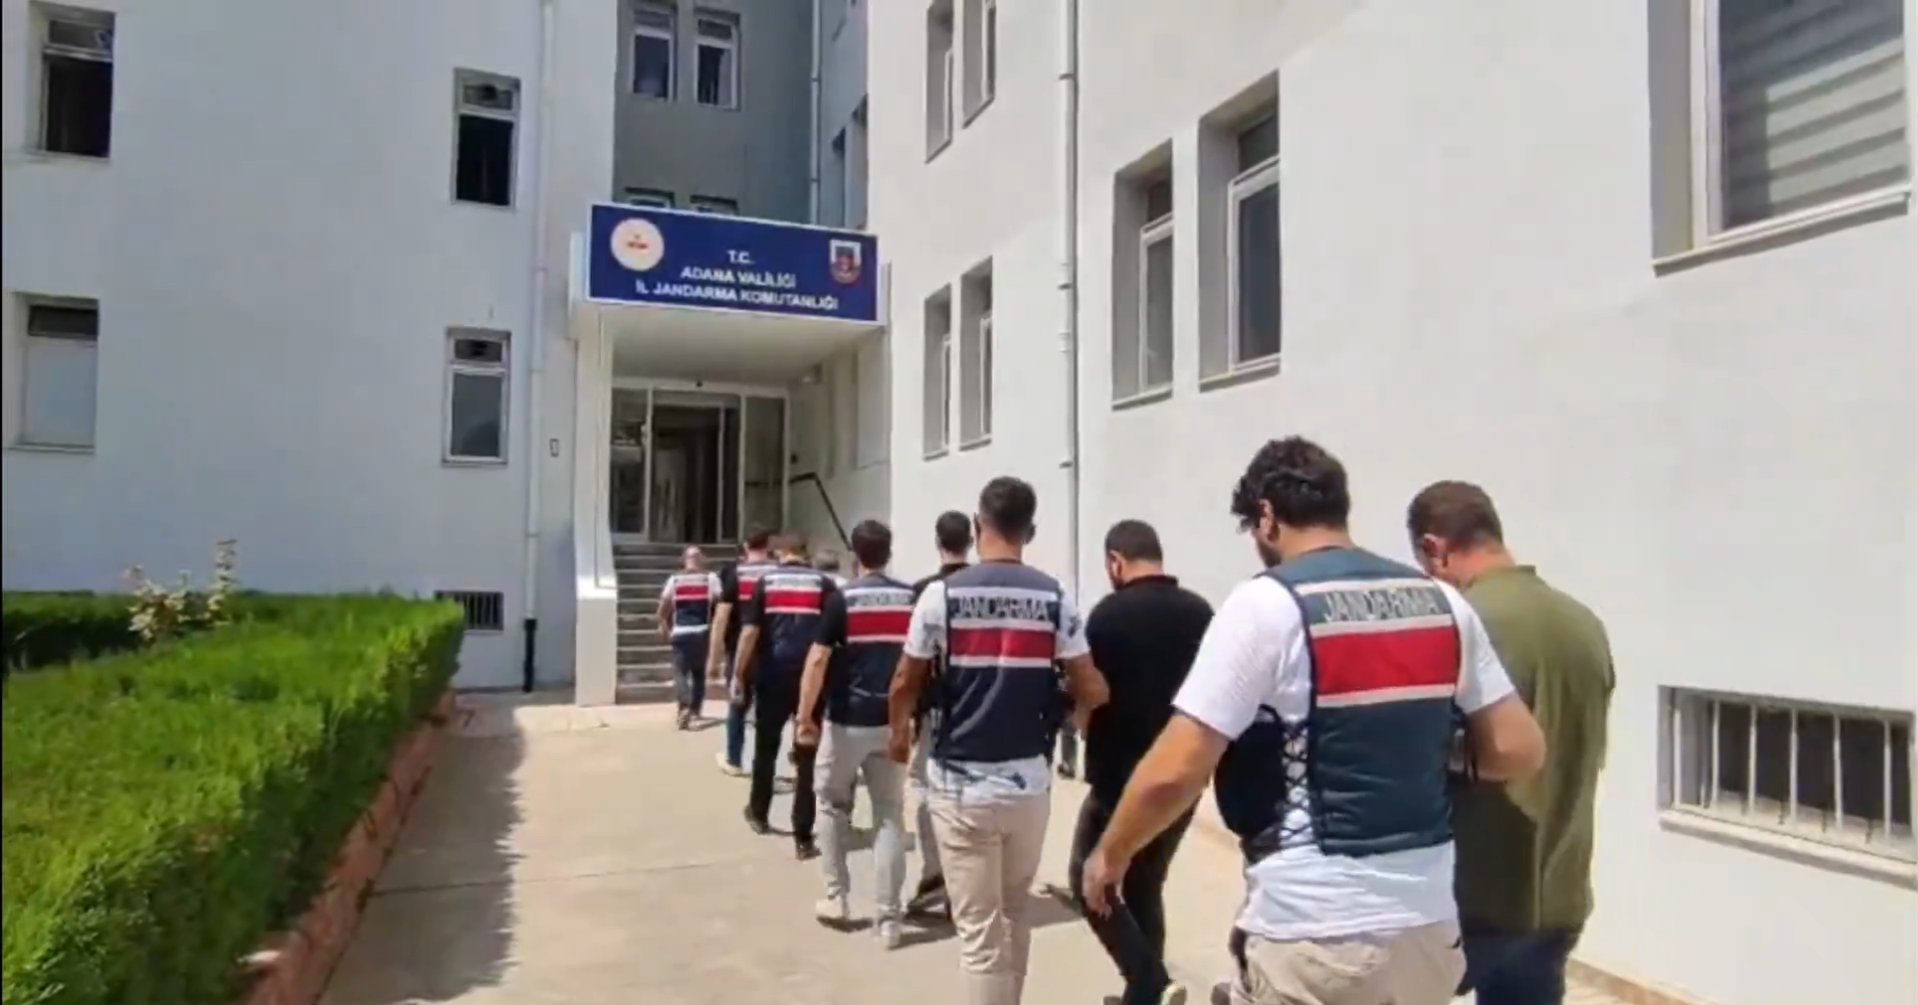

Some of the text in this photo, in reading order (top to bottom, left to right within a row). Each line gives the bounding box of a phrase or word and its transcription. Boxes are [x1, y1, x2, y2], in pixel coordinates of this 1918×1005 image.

[727, 249, 755, 264] T.C.
[680, 266, 736, 284] ADANA
[652, 282, 737, 301] JANDARMA
[953, 596, 1048, 621] JANDARMA
[1324, 586, 1441, 622] JANDARMA
